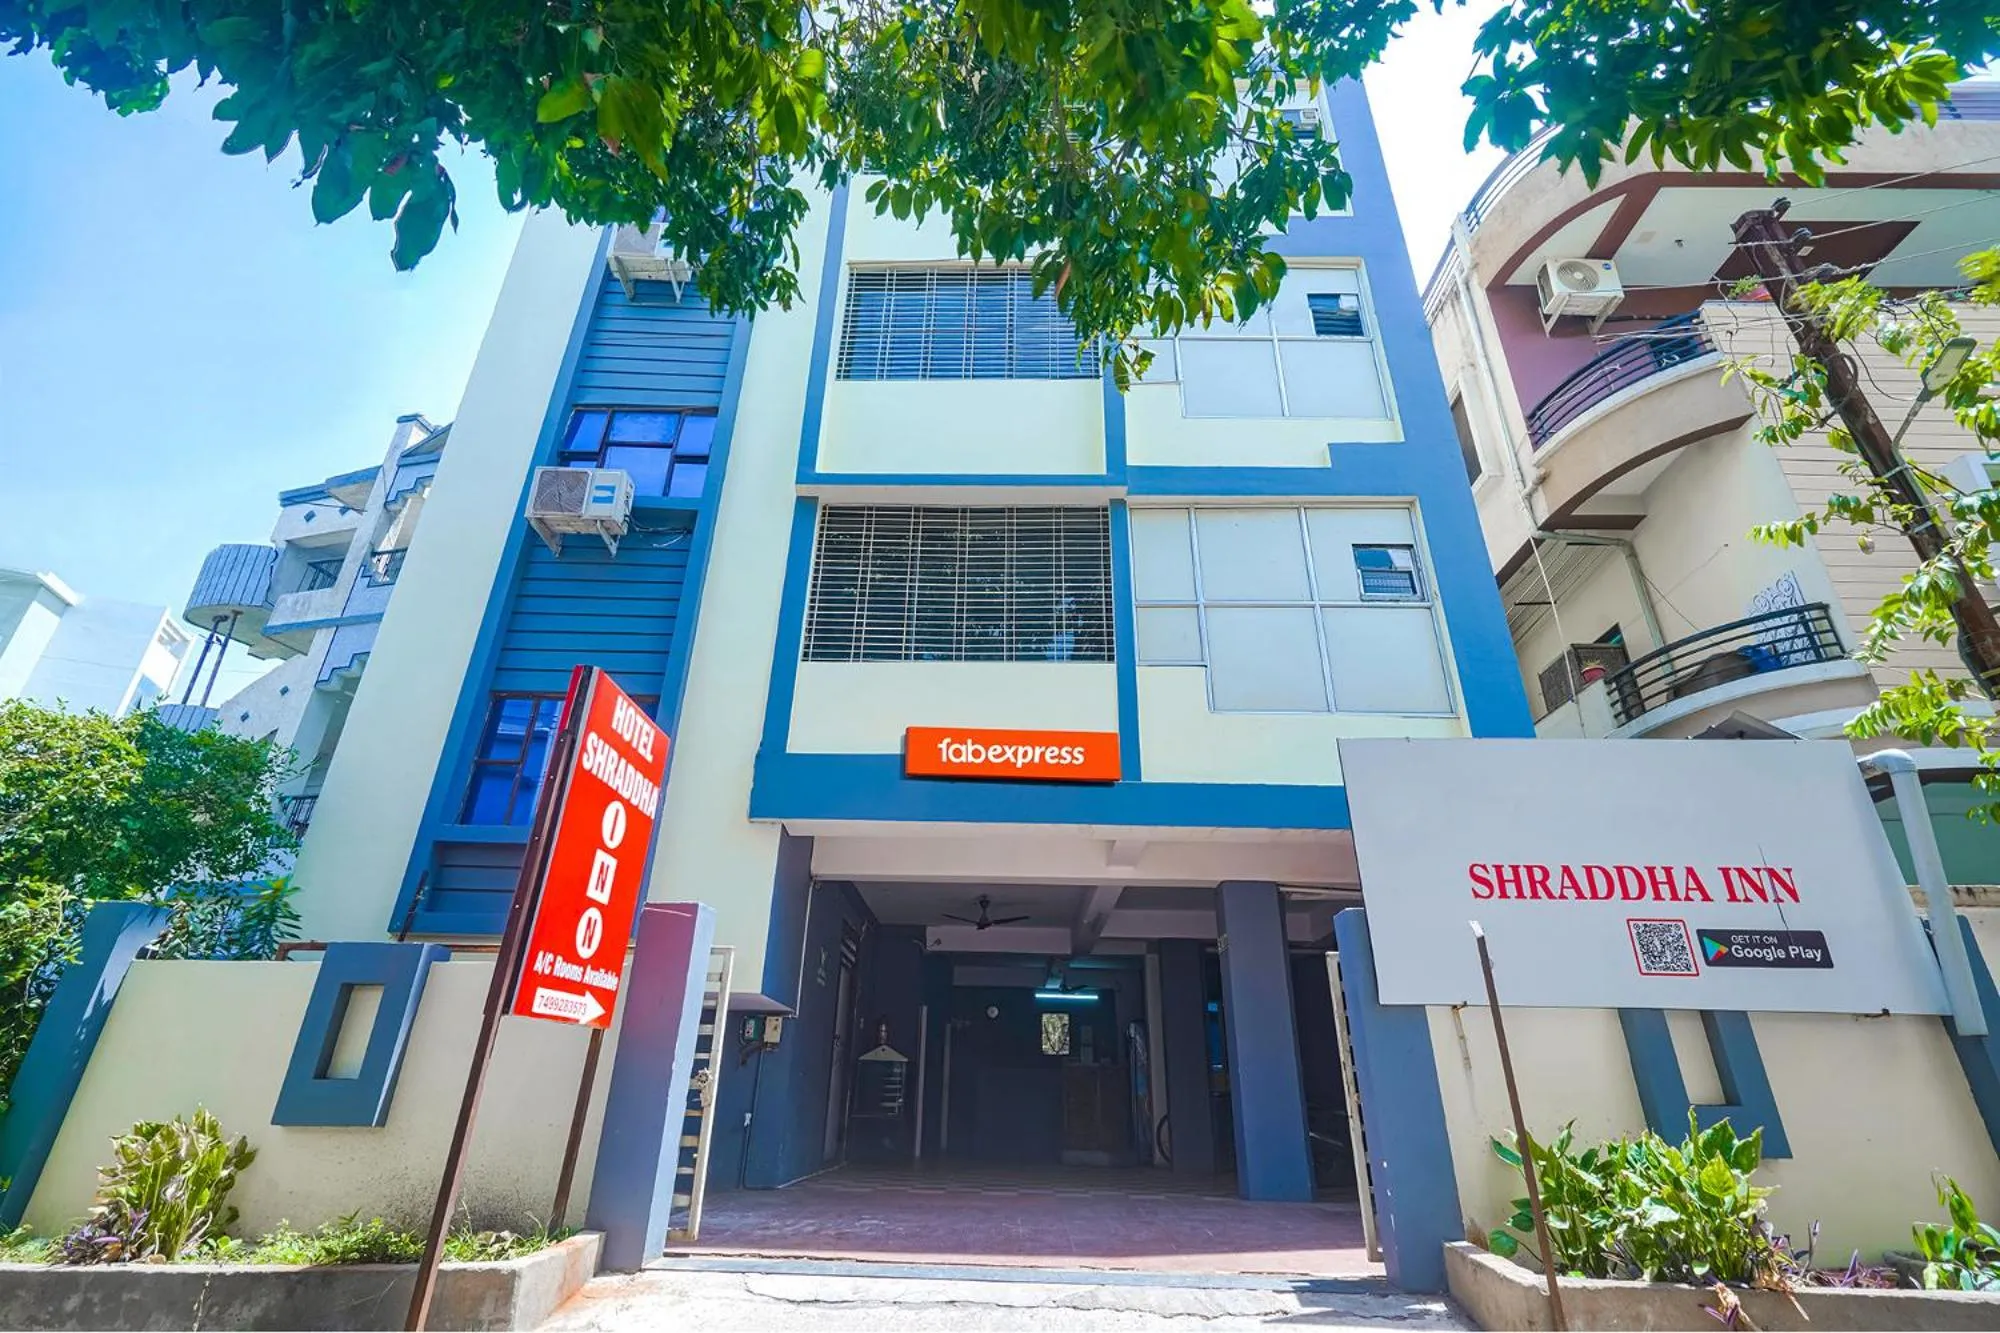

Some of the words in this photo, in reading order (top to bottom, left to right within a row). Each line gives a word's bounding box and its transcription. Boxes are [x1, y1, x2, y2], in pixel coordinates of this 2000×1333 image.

[612, 695, 655, 763] HOTEL
[938, 738, 1085, 768] fabexpress
[582, 732, 660, 820] SHRADDHA
[1469, 863, 1714, 903] SHRADDHA
[1718, 867, 1801, 903] INN
[1731, 935, 1750, 944] GET
[1751, 935, 1761, 944] IT
[1762, 935, 1778, 944] ON
[1731, 945, 1785, 961] Google
[1788, 945, 1821, 962] Play
[533, 950, 554, 975] A/C
[553, 954, 584, 982] Rooms
[583, 964, 619, 991] Available
